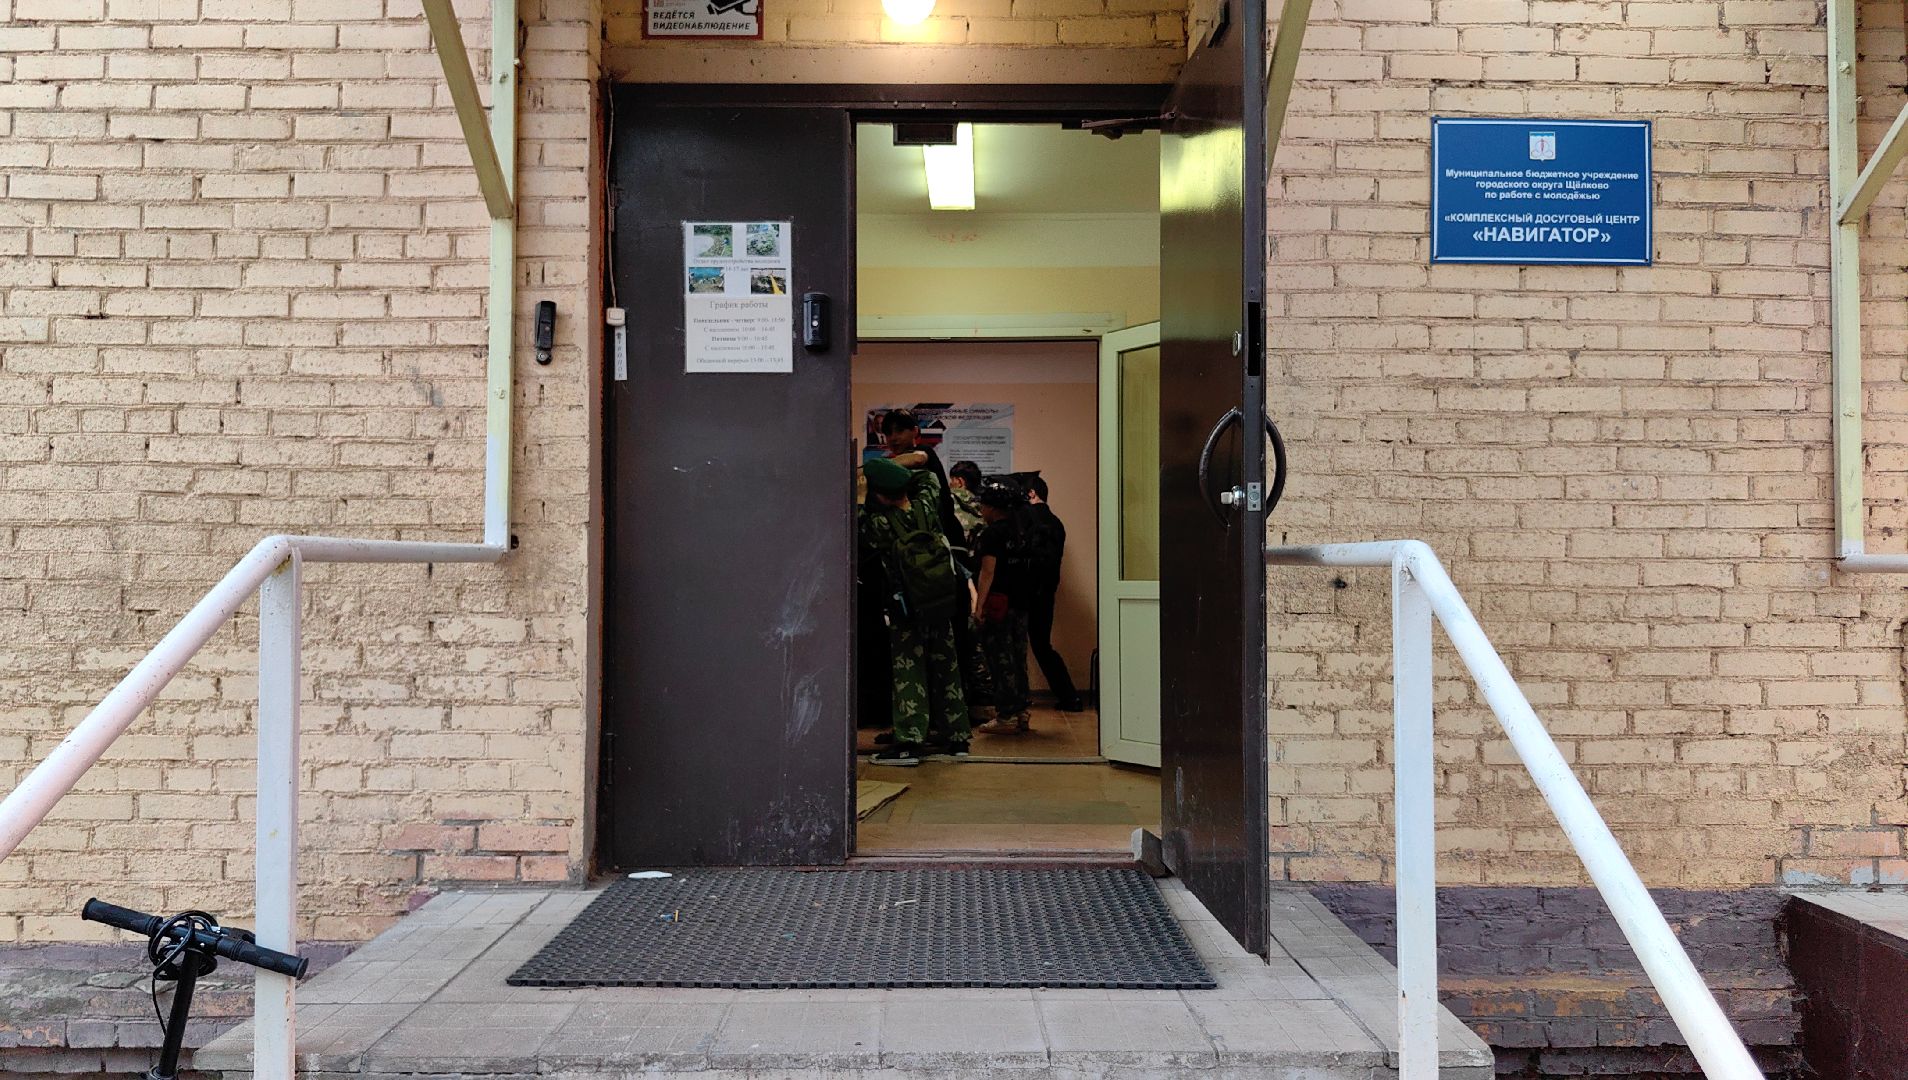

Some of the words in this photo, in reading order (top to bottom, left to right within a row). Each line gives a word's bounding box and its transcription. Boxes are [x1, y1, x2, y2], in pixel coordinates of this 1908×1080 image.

[653, 10, 695, 20] ВЕДЁТСЯ
[653, 22, 751, 31] ВИДЕОНАБЛЮДЕНИЕ
[1445, 169, 1523, 179] Муниципальное
[1525, 169, 1579, 179] бюджетное
[1581, 171, 1639, 181] учреждение
[1476, 181, 1529, 190] городского
[1531, 181, 1563, 190] округа
[1565, 180, 1609, 190] Щёлково
[1485, 191, 1497, 199] по
[1499, 191, 1533, 200] работе
[1543, 191, 1601, 201] молодёжью
[1444, 212, 1534, 224] «КОМПЛЕКСНЫЙ
[1535, 212, 1603, 225] ДОСУГОВЫЙ
[1605, 214, 1640, 225] ЦЕНТР
[1472, 226, 1611, 243] «НАВИГАТОР»
[709, 301, 738, 310] График
[740, 301, 769, 310] работы
